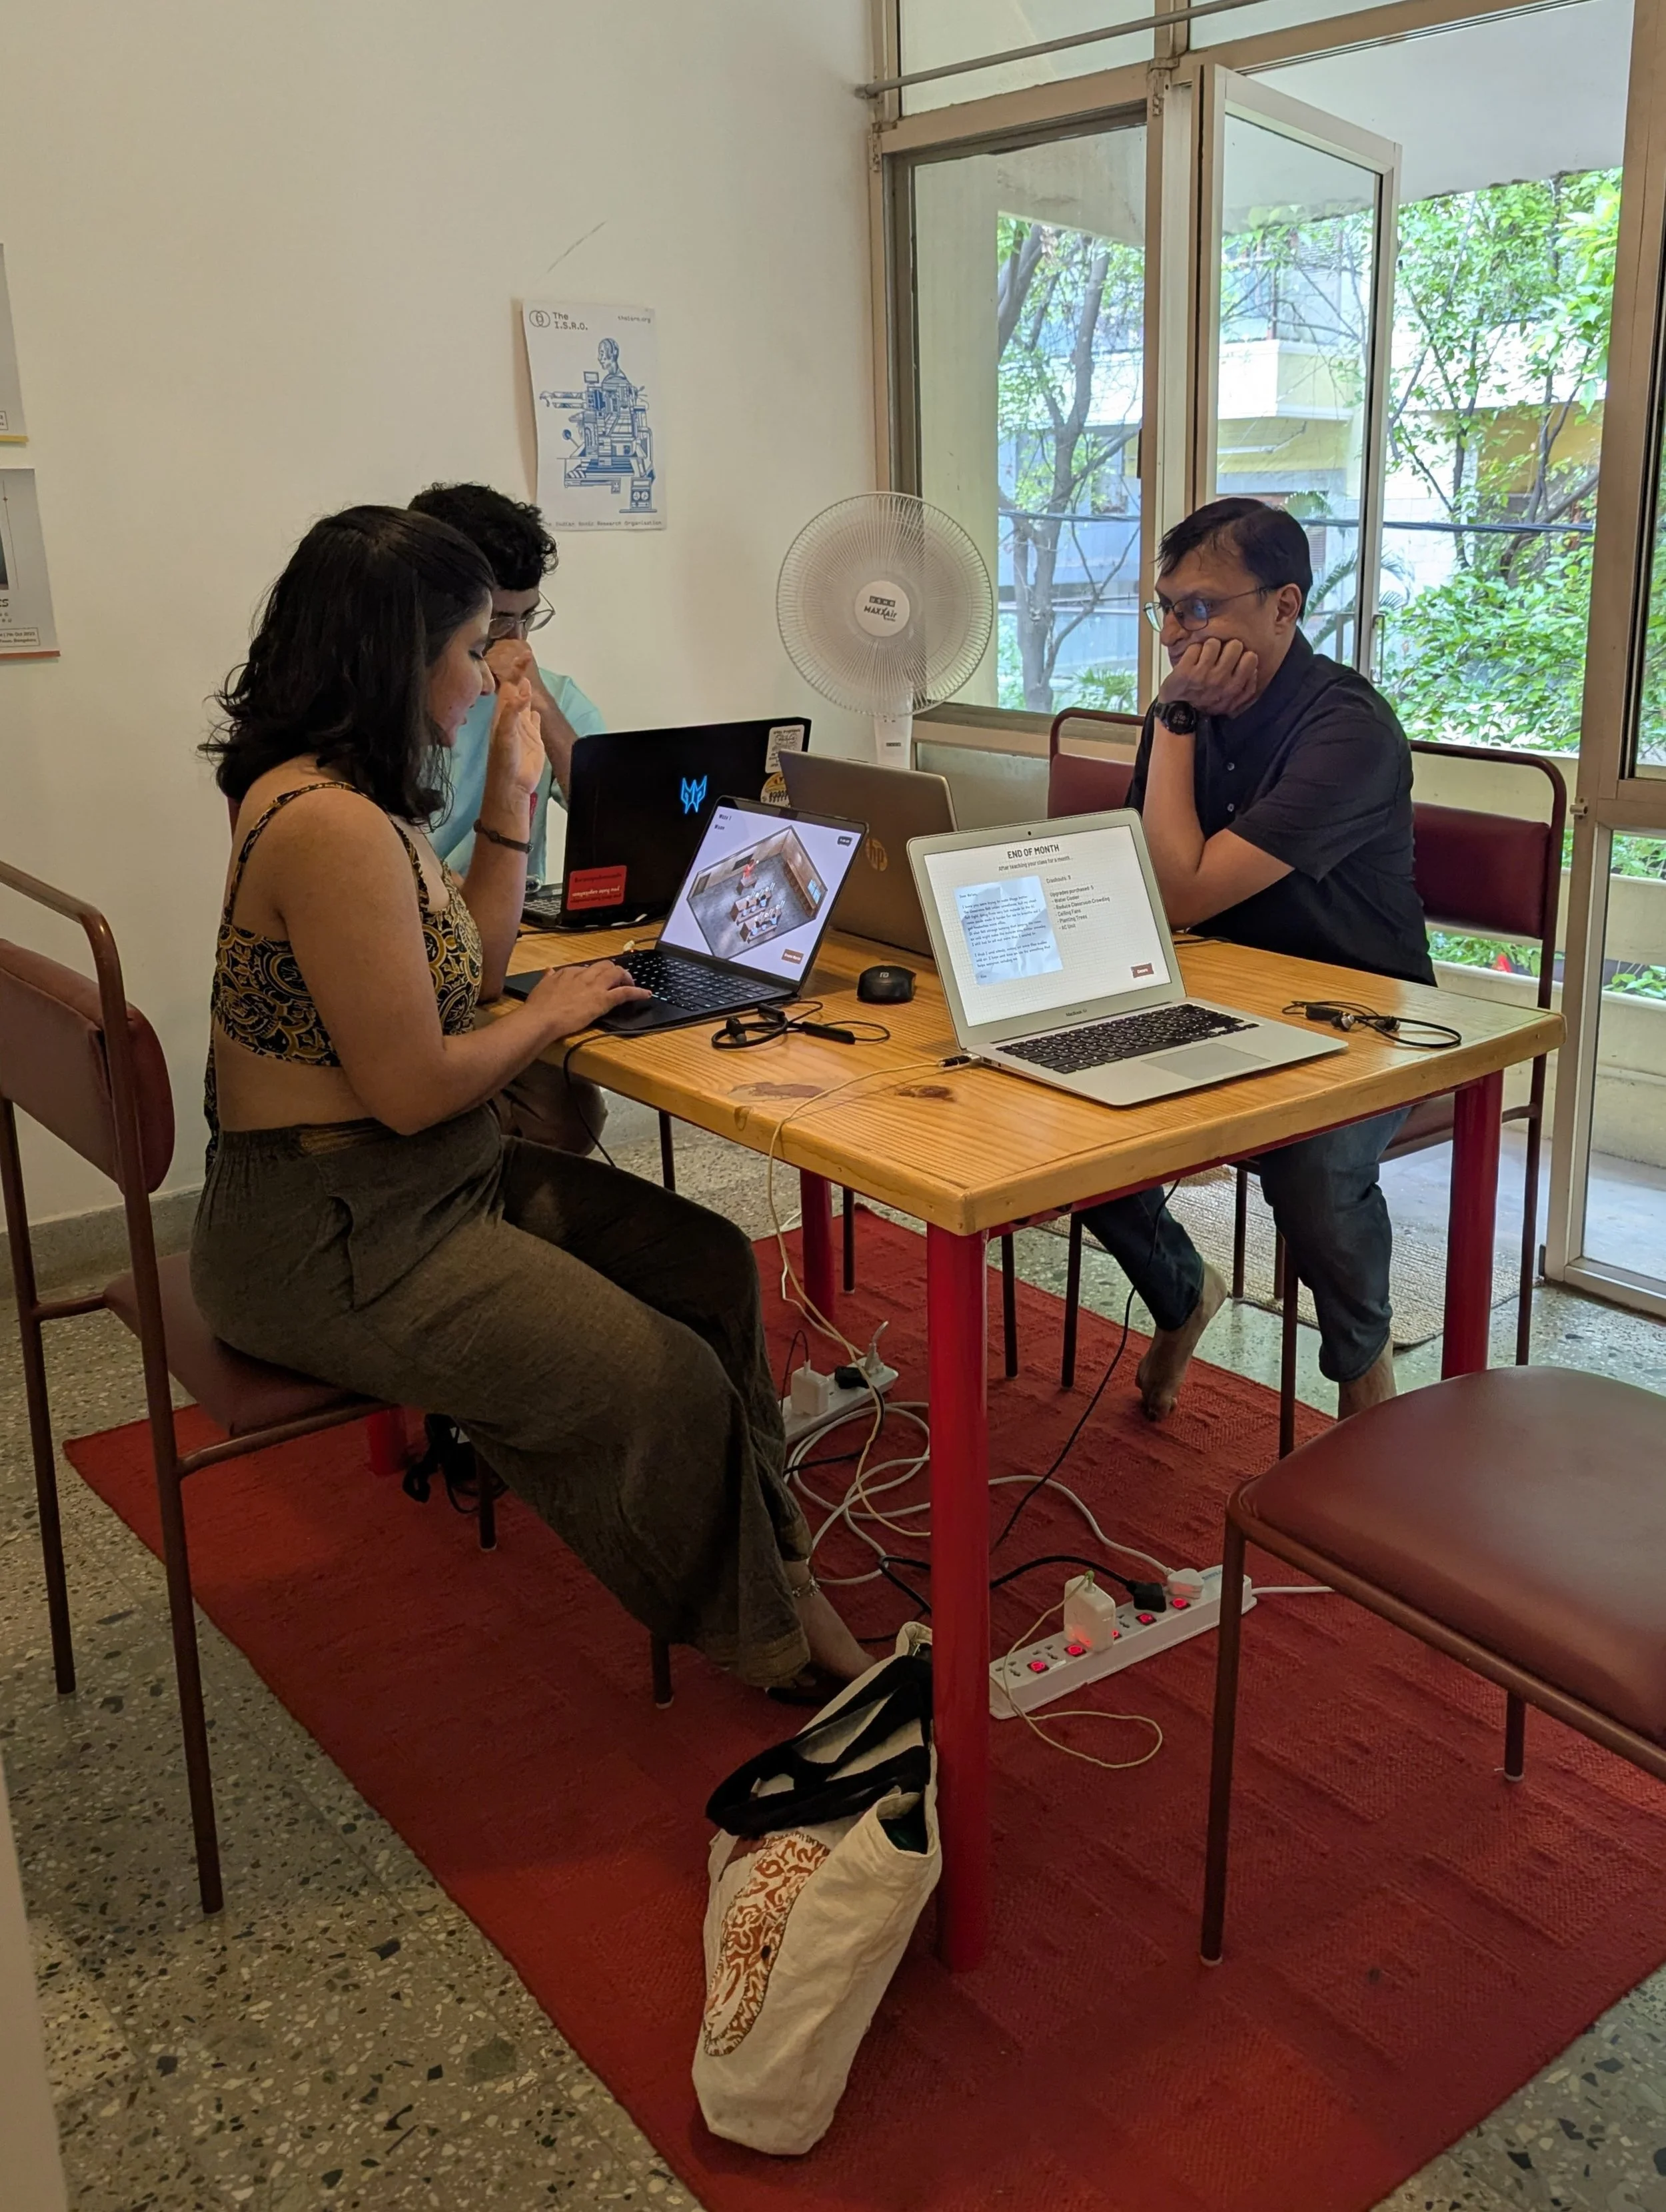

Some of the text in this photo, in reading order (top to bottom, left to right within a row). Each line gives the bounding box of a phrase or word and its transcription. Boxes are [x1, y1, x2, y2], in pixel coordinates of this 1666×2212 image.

[552, 312, 568, 320] The
[554, 321, 588, 330] I.S.R.O.
[1007, 844, 1060, 859] END OF MONTH
